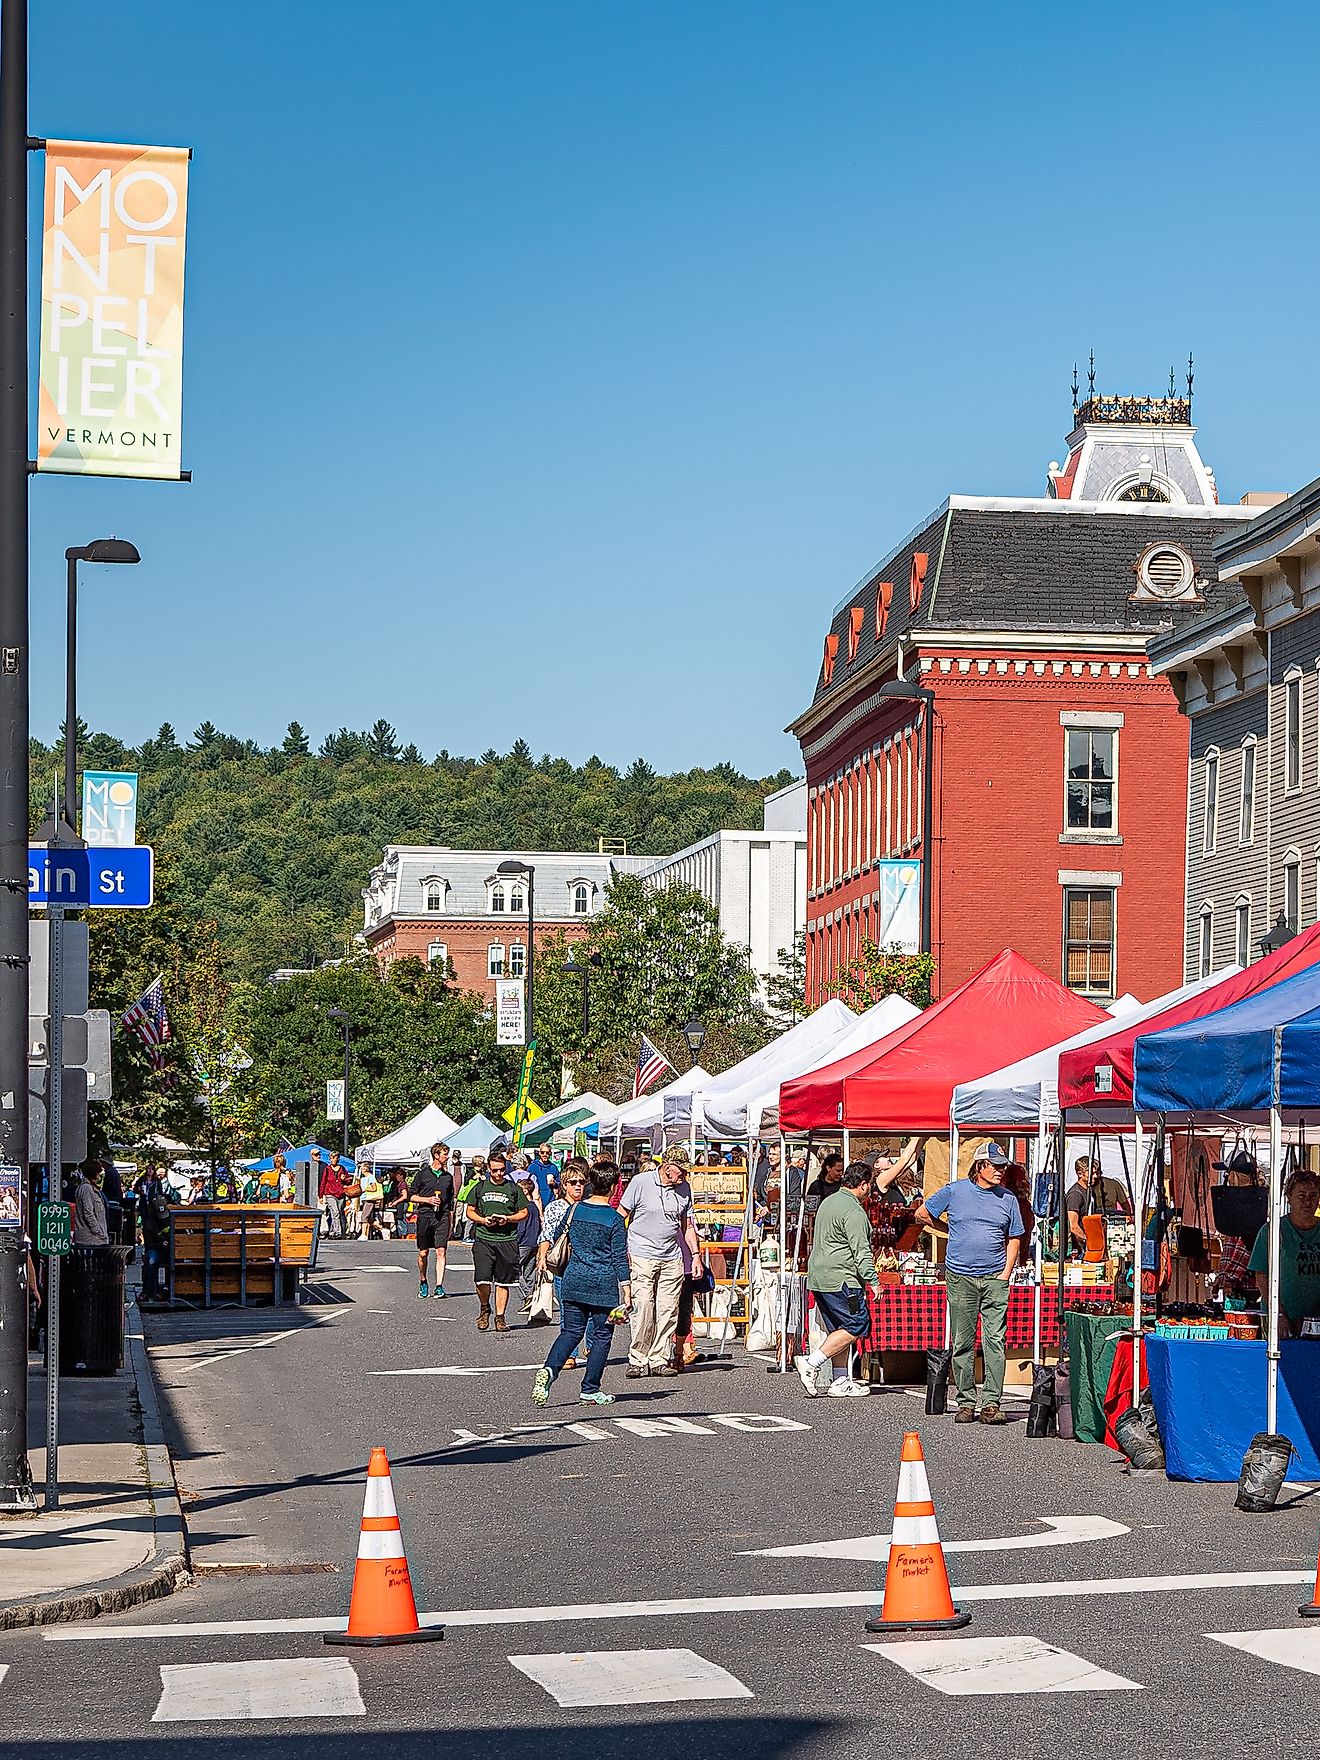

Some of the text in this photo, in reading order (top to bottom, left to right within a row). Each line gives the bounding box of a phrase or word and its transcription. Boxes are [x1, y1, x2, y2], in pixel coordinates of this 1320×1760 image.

[53, 165, 178, 232] MO
[53, 229, 178, 296] NT
[50, 292, 173, 359] PEL
[56, 355, 171, 420] IER
[47, 427, 173, 448] VERMONT
[86, 780, 134, 806] MO
[86, 804, 133, 829] NT
[28, 859, 125, 893] ain St
[41, 1206, 69, 1219] 9995
[46, 1222, 64, 1234] 1211
[40, 1237, 69, 1250] 0046
[896, 1553, 934, 1567] Farmer's
